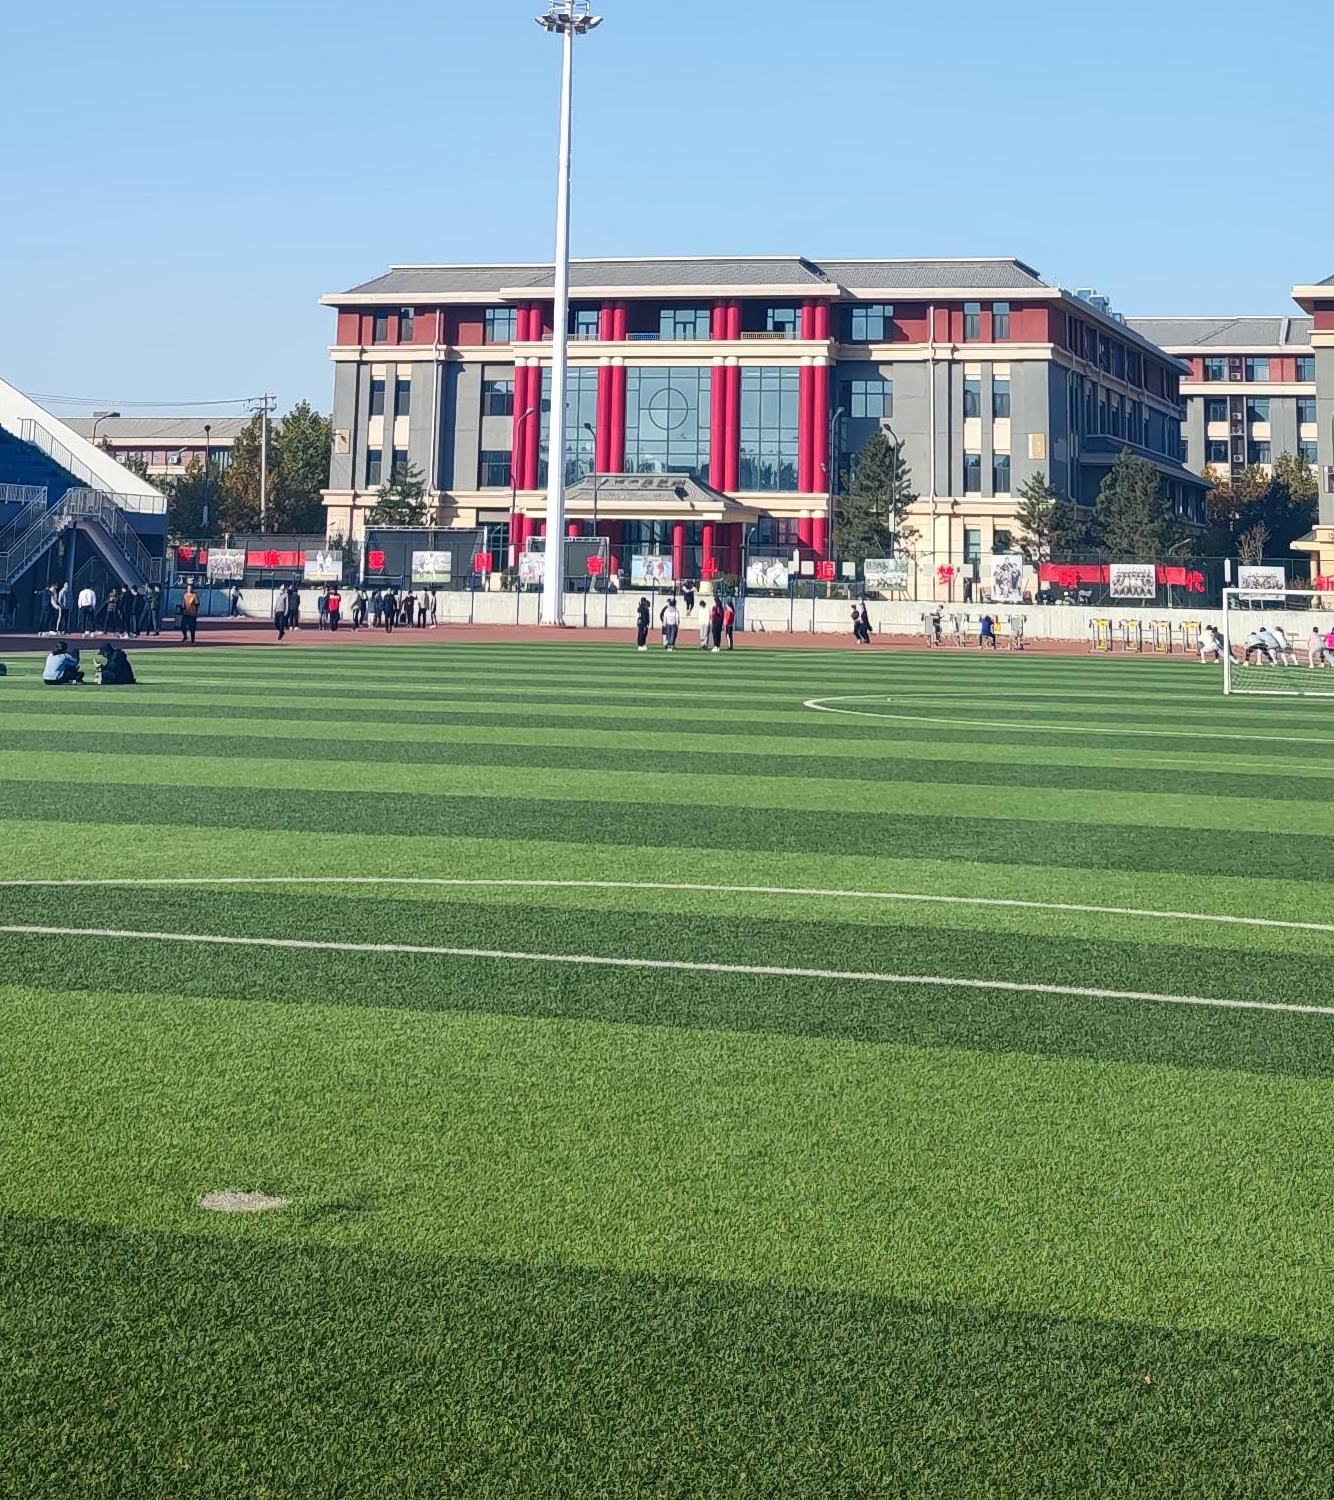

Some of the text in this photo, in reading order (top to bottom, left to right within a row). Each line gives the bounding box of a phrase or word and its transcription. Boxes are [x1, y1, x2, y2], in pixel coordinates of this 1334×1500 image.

[816, 560, 836, 581] 追
[937, 565, 955, 585] 梦
[1185, 570, 1205, 593] 代
